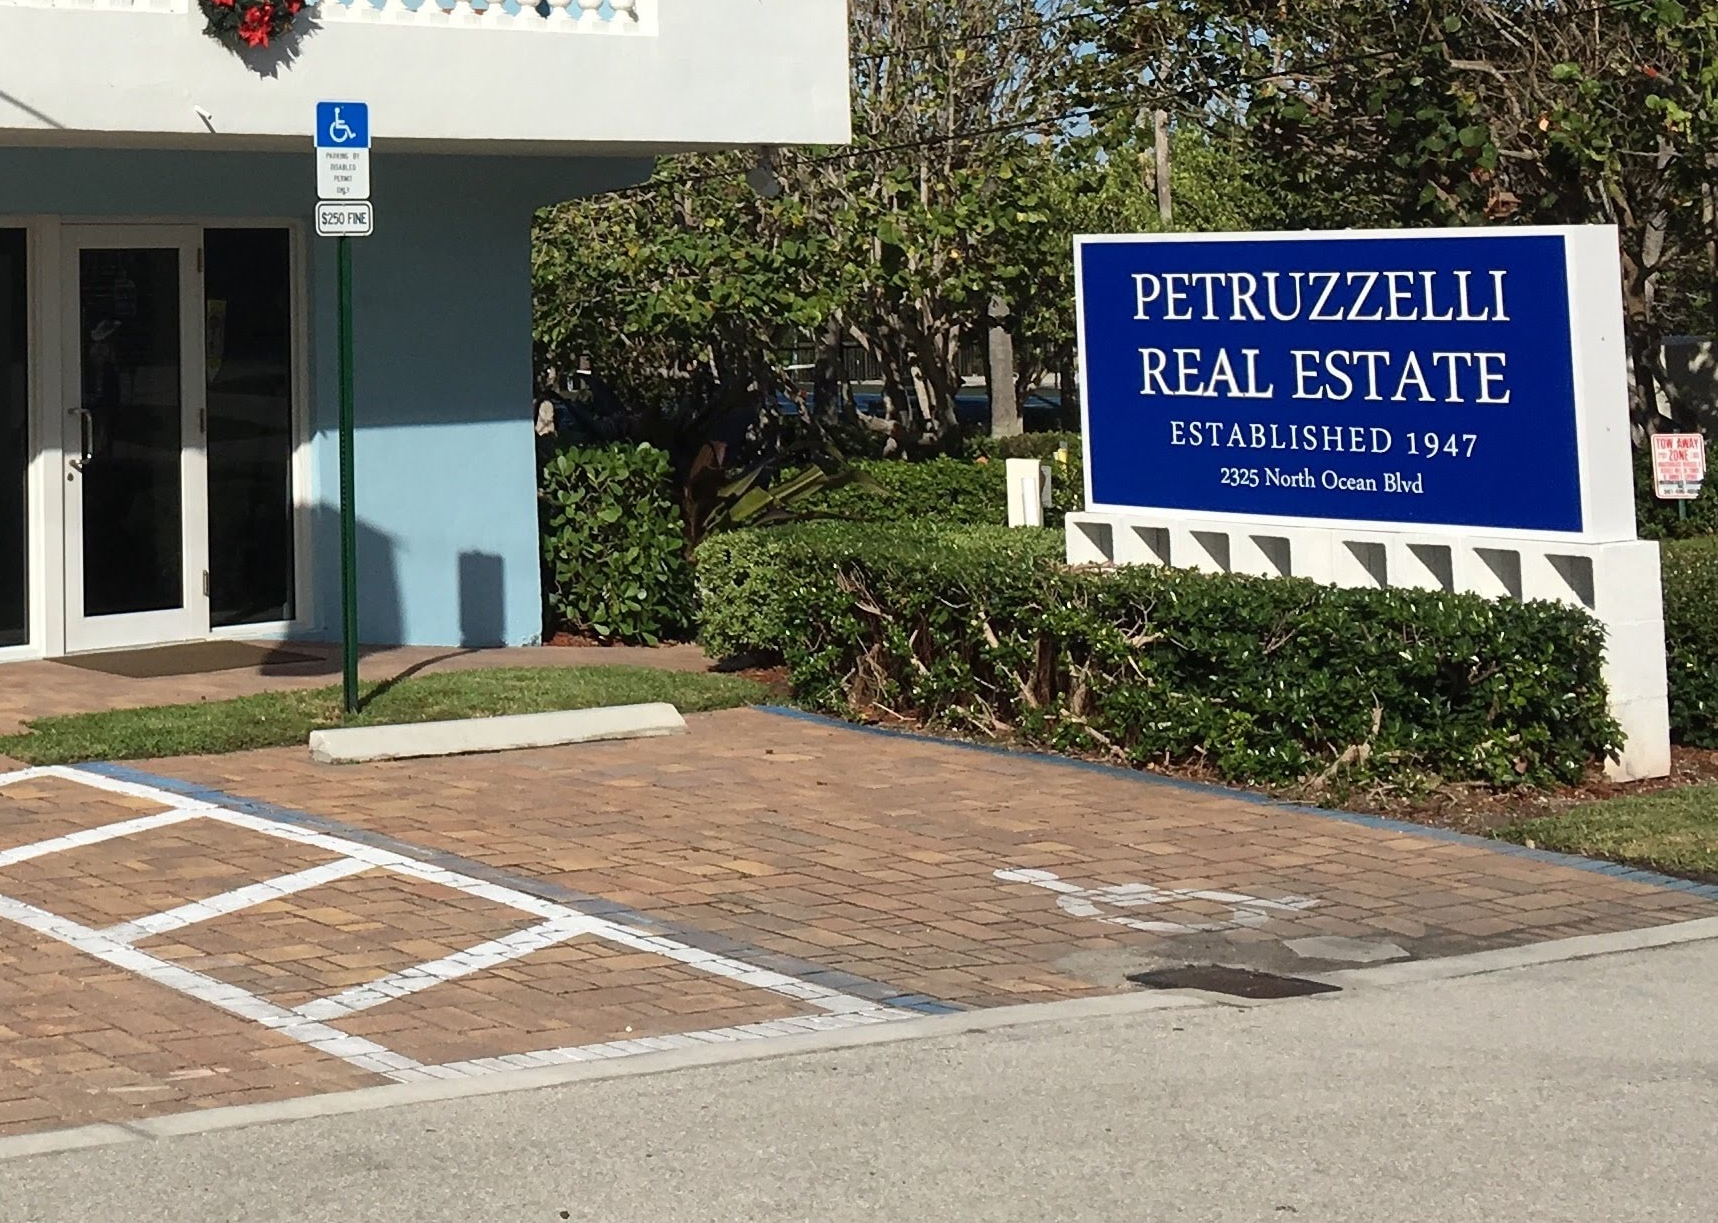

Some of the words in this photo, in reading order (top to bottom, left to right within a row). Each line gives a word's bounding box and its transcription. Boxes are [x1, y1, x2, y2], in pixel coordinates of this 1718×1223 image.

[330, 163, 357, 171] DISABLED
[321, 212, 345, 226] $250
[348, 211, 367, 226] FINE
[1131, 270, 1511, 322] PETRUZZELLI
[1138, 347, 1274, 399] REAL
[1291, 350, 1511, 405] ESTATE
[1170, 421, 1393, 454] ESTABLISHED
[1407, 432, 1479, 458] 1947
[1656, 437, 1673, 449] TOW
[1677, 437, 1699, 449] AWAY
[1669, 449, 1689, 461] ZONE
[1220, 467, 1260, 488] 2325
[1265, 468, 1316, 490] North
[1321, 470, 1378, 492] Ocean
[1383, 471, 1424, 495] Blvd
